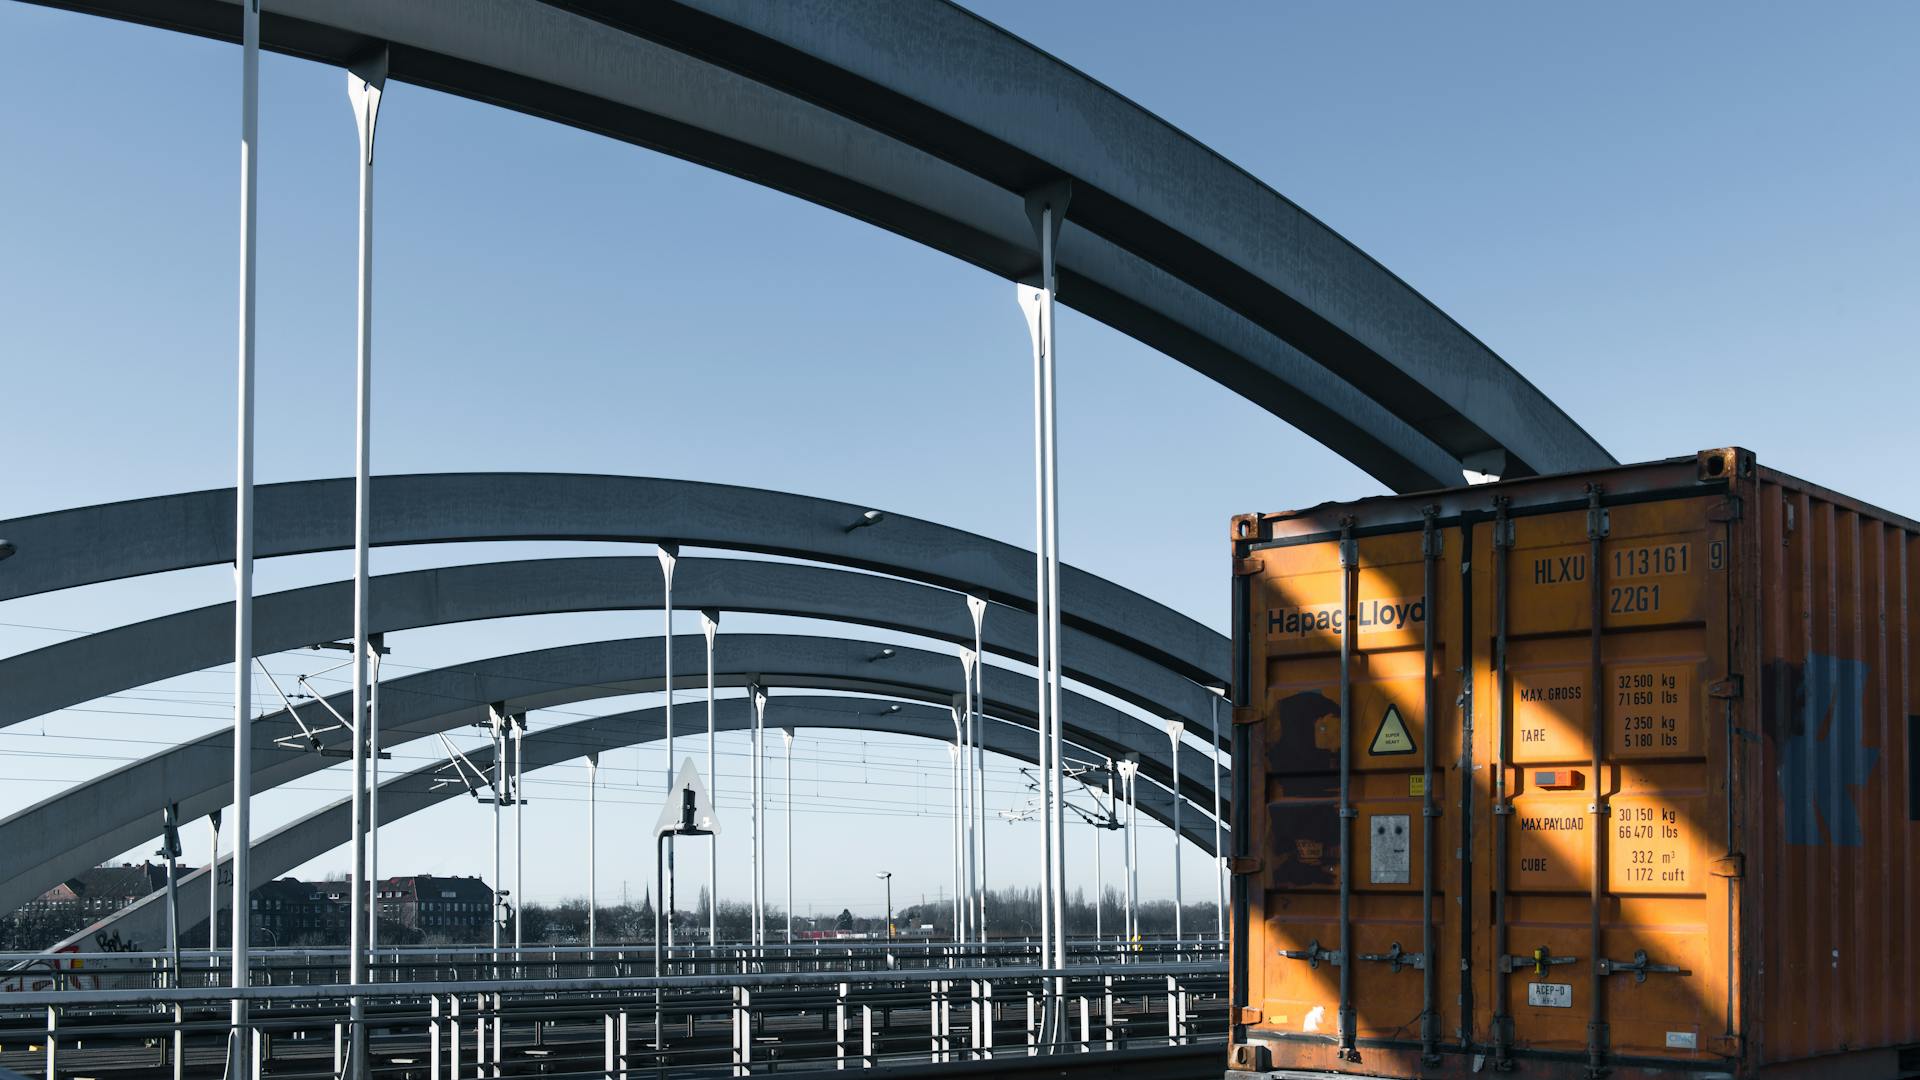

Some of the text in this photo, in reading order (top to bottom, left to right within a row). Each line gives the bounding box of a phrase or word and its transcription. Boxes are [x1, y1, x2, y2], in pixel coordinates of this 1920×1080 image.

[1535, 543, 1722, 584] HLXU 113161 9
[1611, 585, 1660, 613] 22G1
[1662, 673, 1675, 688] kg
[1548, 686, 1581, 700] GROSS
[1662, 691, 1677, 704] lbs
[1662, 715, 1675, 731] kg
[1521, 729, 1546, 742] TARE
[1662, 733, 1677, 746] lbs
[1662, 807, 1675, 824] kg
[1662, 825, 1678, 838] lbs
[1632, 850, 1653, 863] 33.2
[1521, 857, 1547, 871] CUBE
[1662, 868, 1685, 881] cuft
